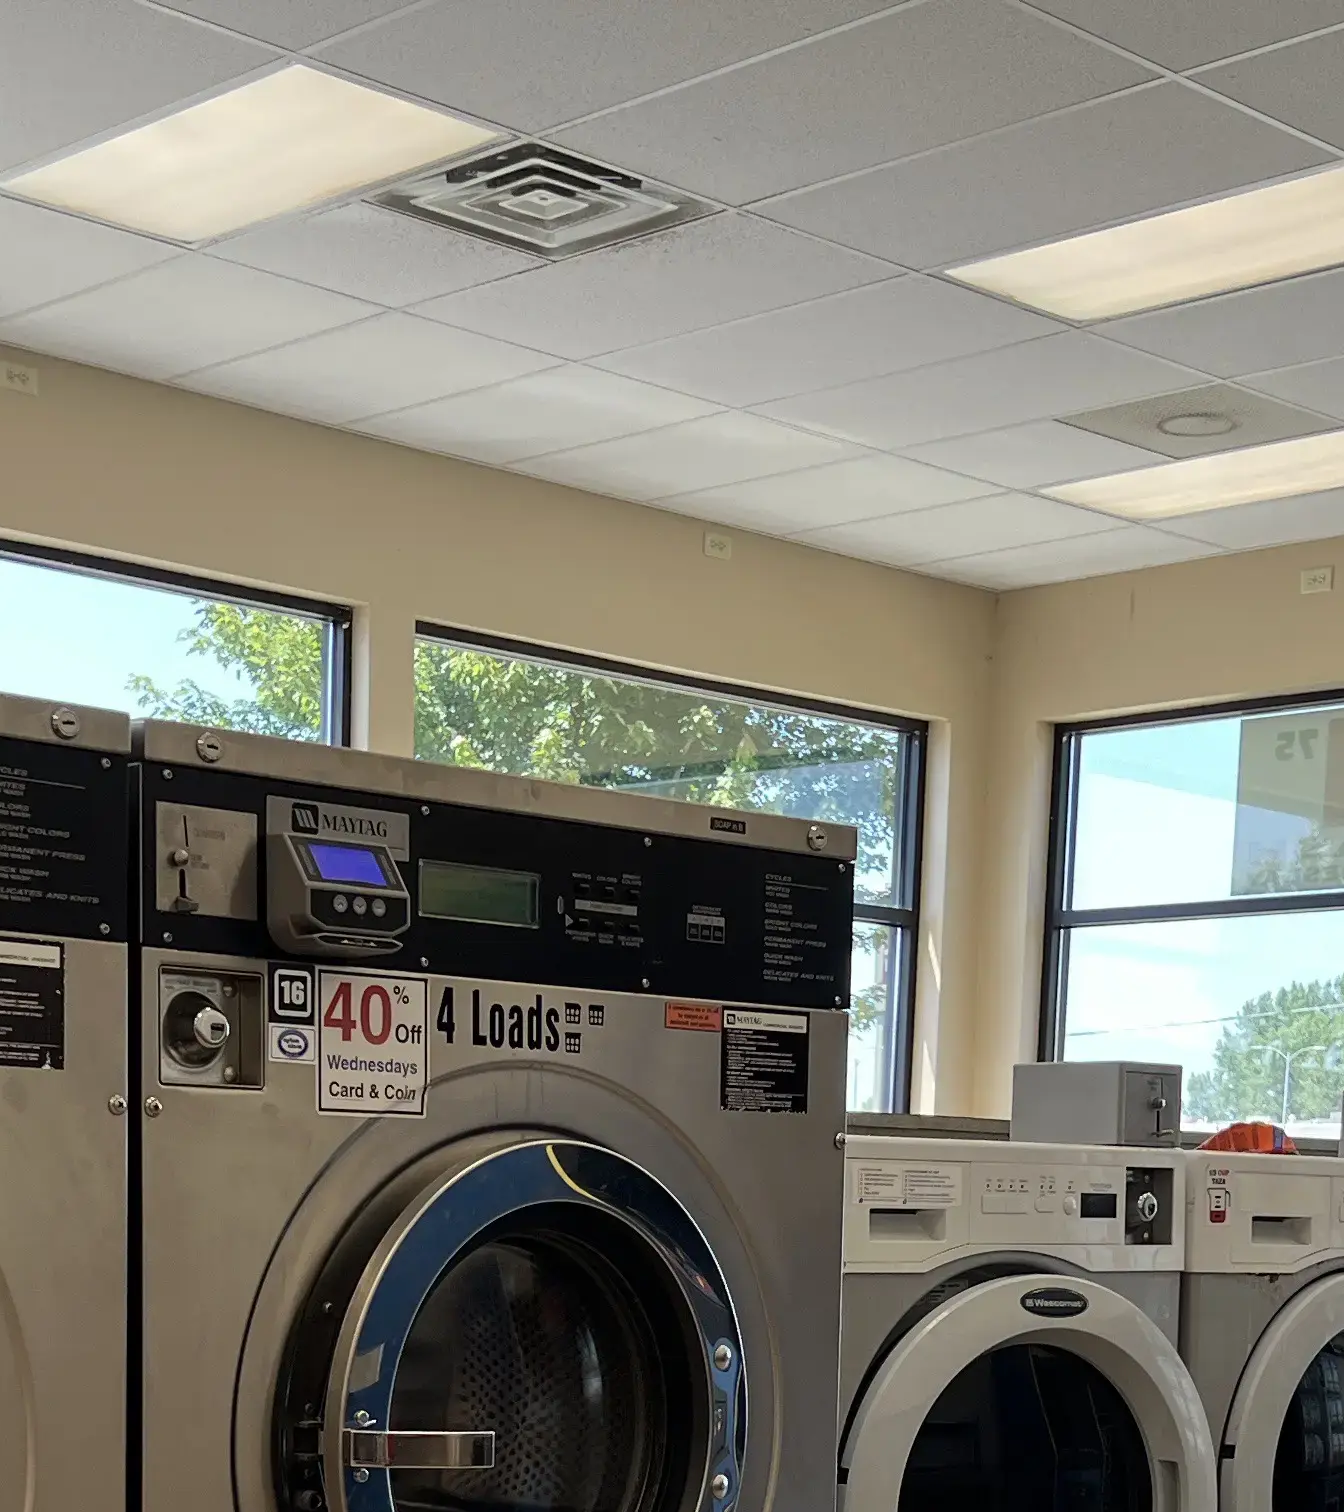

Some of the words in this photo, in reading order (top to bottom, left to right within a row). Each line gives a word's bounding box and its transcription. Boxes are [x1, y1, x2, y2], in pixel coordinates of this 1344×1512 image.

[322, 814, 387, 837] MAYTAG
[280, 981, 304, 1005] 16
[437, 986, 456, 1044] 4
[472, 988, 560, 1052] Loads
[395, 1024, 422, 1045] Off
[327, 1055, 418, 1076] Wednesdays
[329, 1082, 365, 1099] Card
[369, 1084, 380, 1099] &
[384, 1085, 416, 1101] Coin
